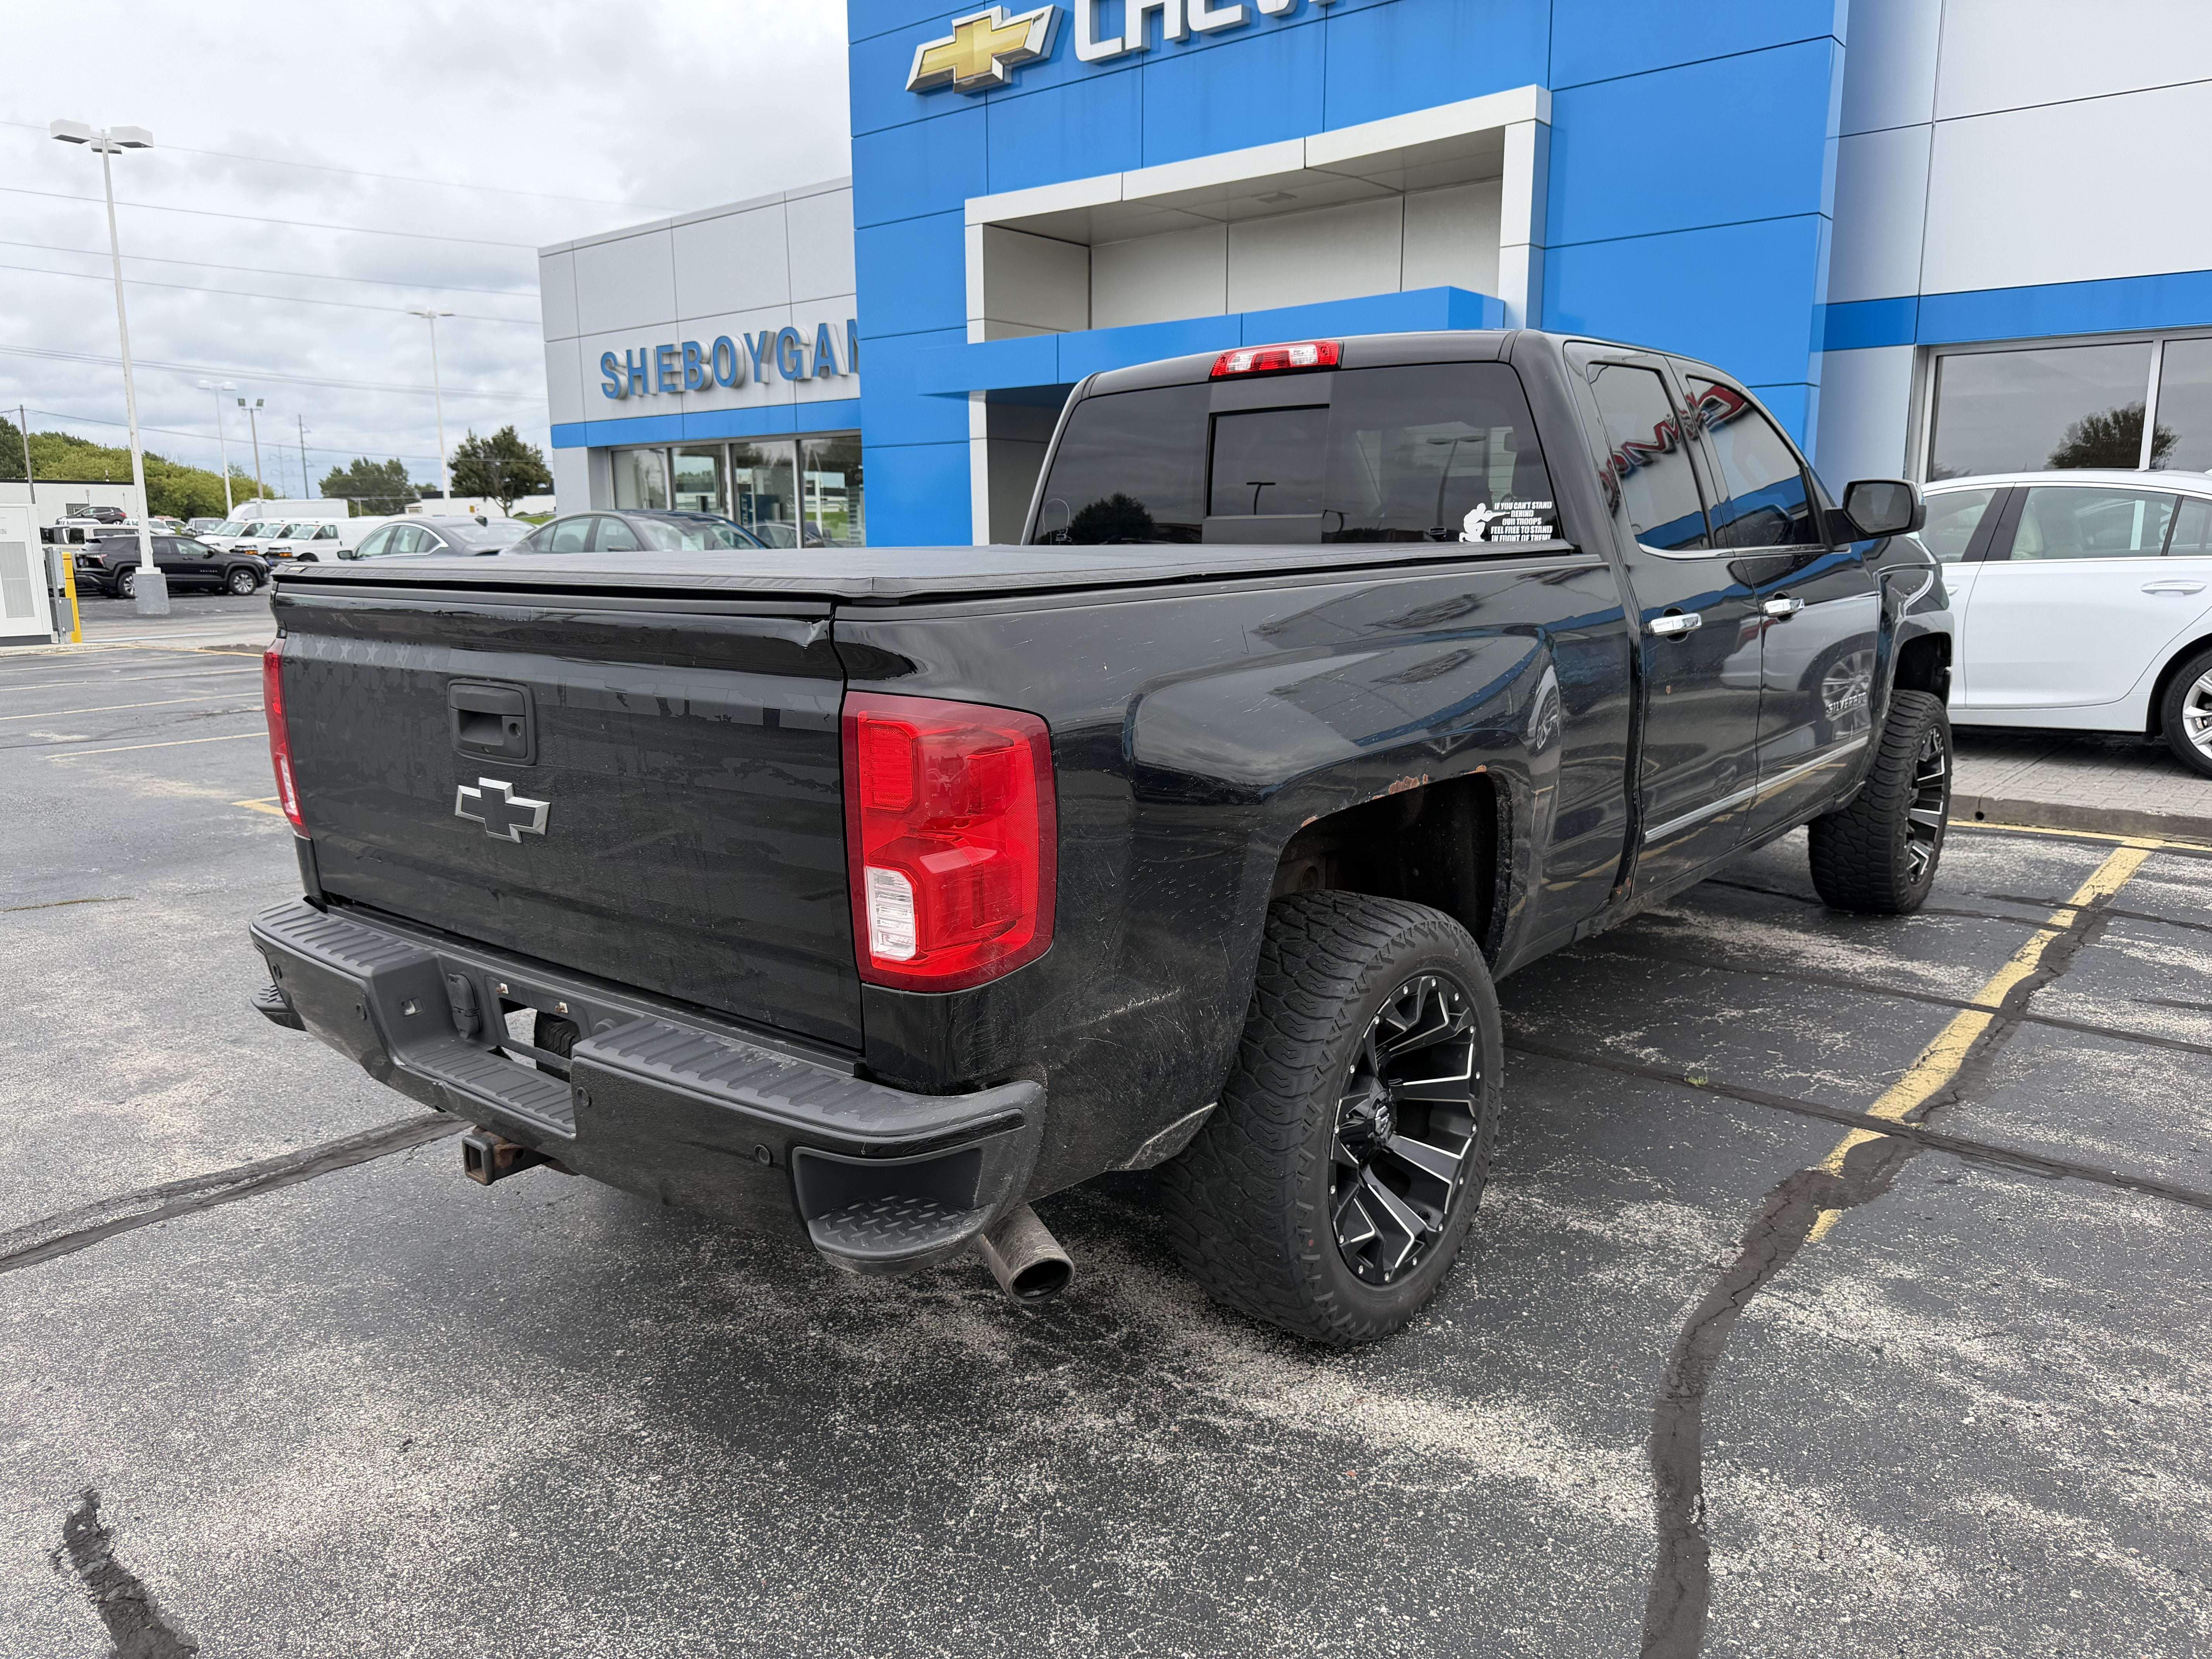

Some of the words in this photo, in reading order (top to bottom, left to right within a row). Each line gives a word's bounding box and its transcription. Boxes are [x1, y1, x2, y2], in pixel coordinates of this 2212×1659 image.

[1513, 501, 1531, 510] CAN'T
[1532, 501, 1552, 509] STAND
[1516, 517, 1542, 525] TROOPS
[1491, 526, 1504, 534] FEEL
[1505, 526, 1520, 534] FREE
[1521, 526, 1530, 534] TO
[1530, 525, 1553, 534] STAND
[1826, 692, 1867, 713] SILVERADO
